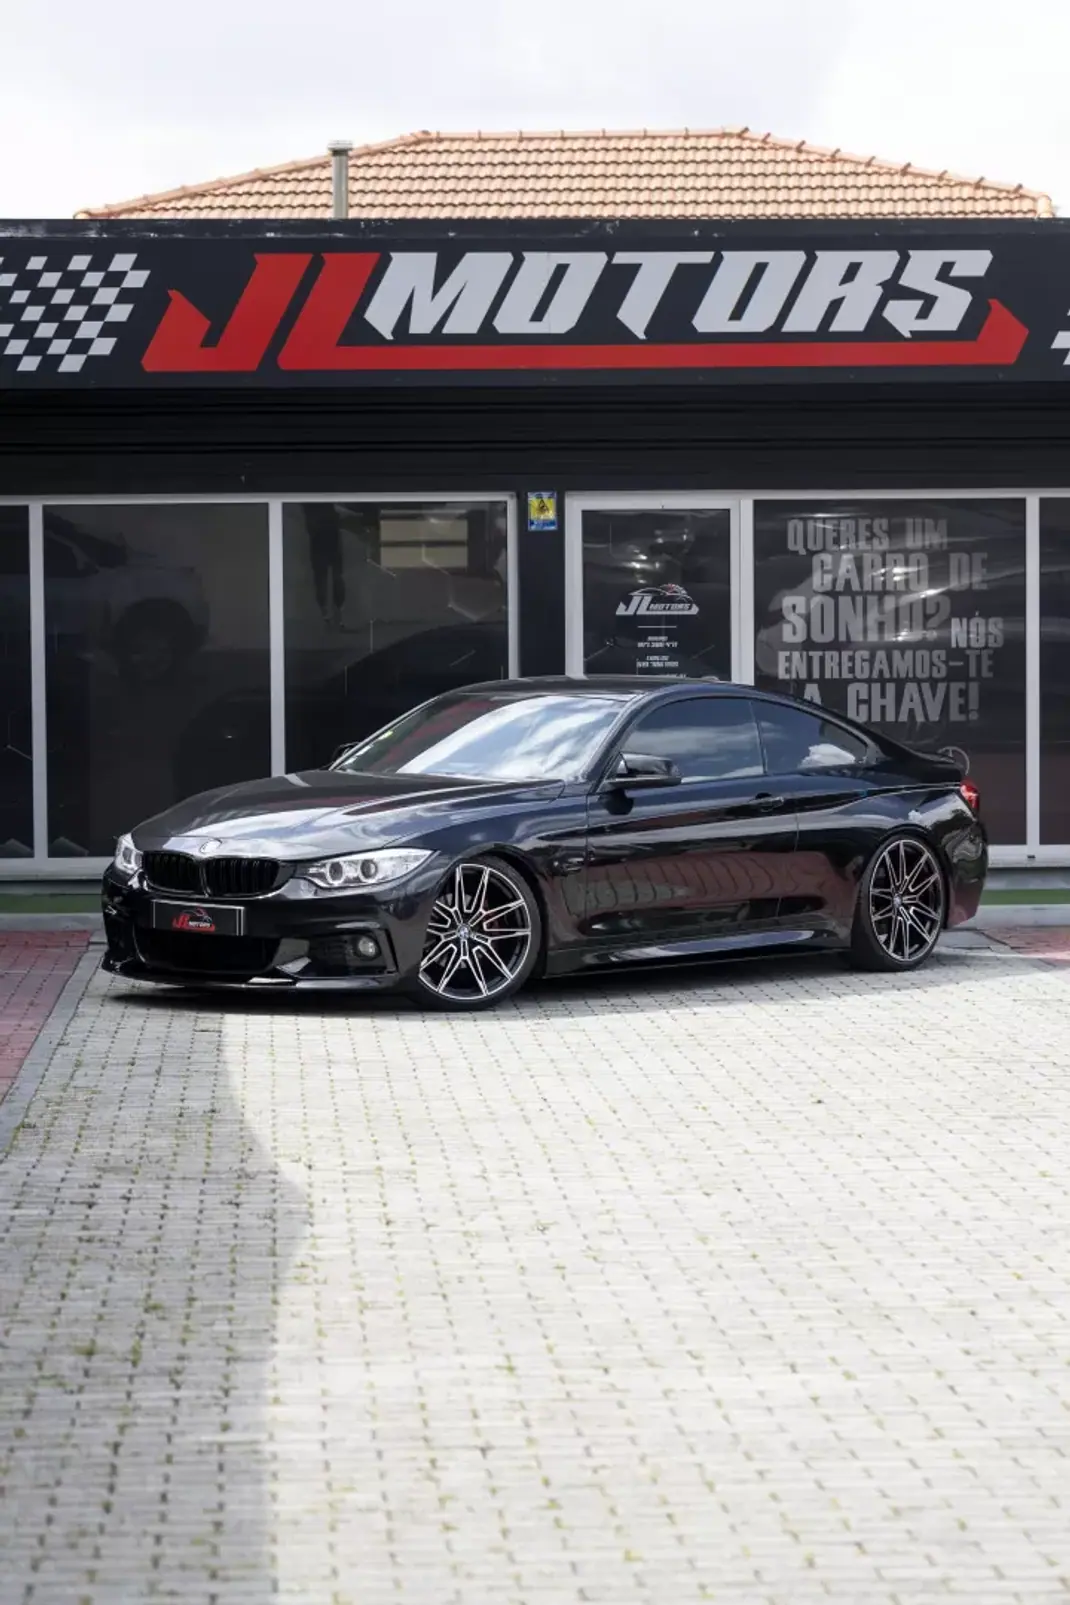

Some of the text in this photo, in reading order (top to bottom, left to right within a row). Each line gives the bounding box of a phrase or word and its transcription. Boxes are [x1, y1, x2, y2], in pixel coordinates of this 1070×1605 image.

[364, 249, 993, 340] MOTORS
[787, 517, 948, 555] QUERES UM
[812, 552, 989, 592] CARRO DE
[782, 595, 1005, 648] SONHO? NÓS
[778, 649, 994, 680] ENTREGAMOS-TE
[847, 681, 981, 723] CHAVE!
